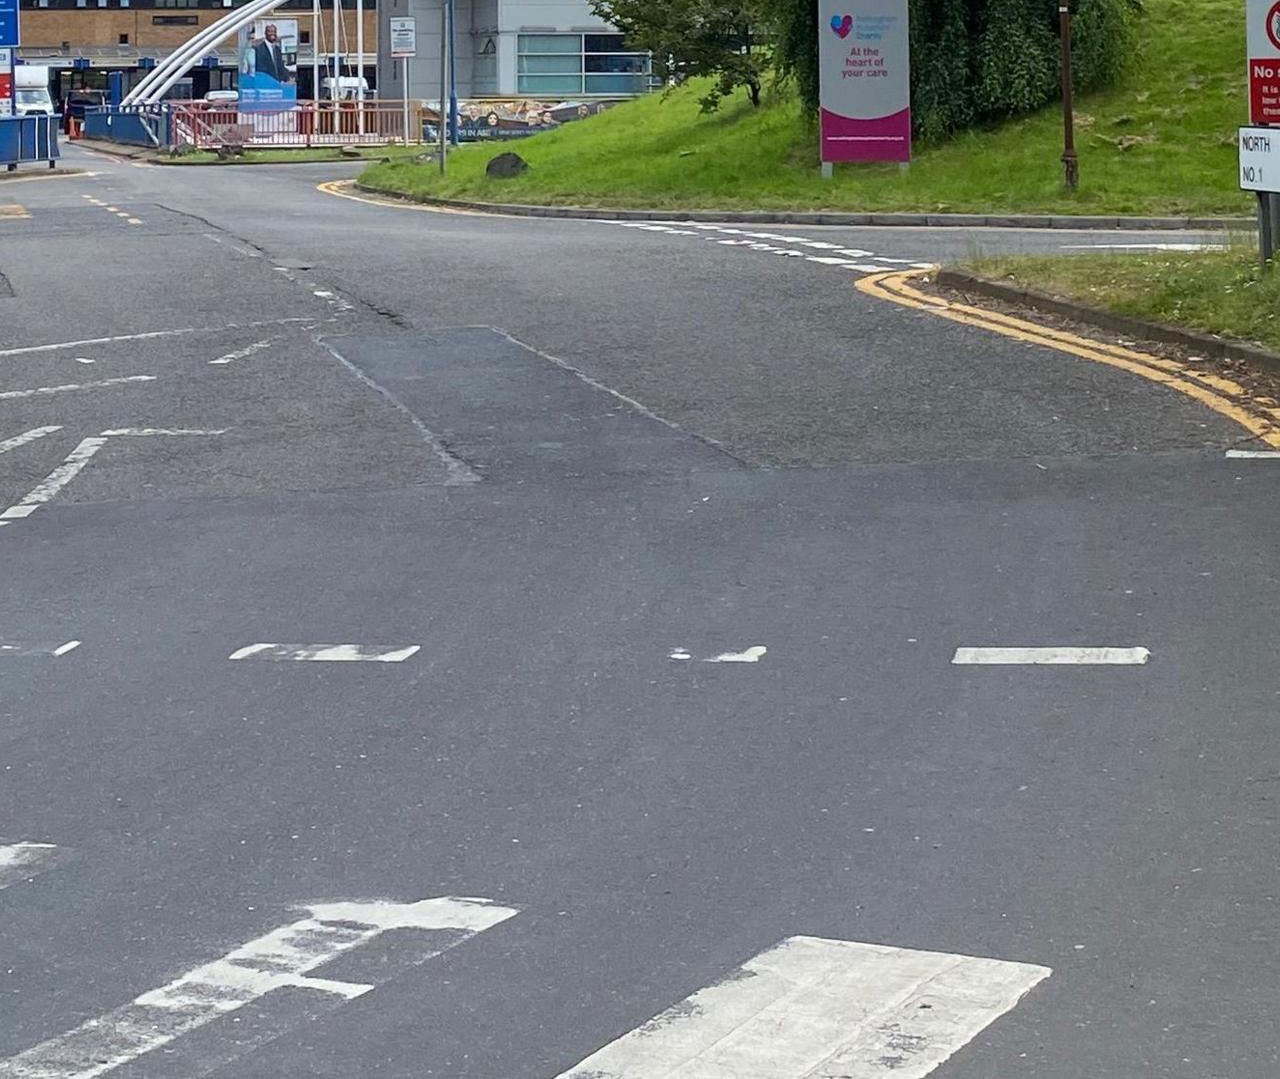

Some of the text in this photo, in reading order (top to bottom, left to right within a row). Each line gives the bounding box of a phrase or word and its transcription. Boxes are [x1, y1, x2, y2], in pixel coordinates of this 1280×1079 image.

[850, 47, 879, 56] At the
[845, 58, 884, 67] heart of
[842, 69, 865, 80] your
[1253, 65, 1274, 79] No
[1262, 96, 1277, 104] law
[1242, 136, 1270, 152] NORTH
